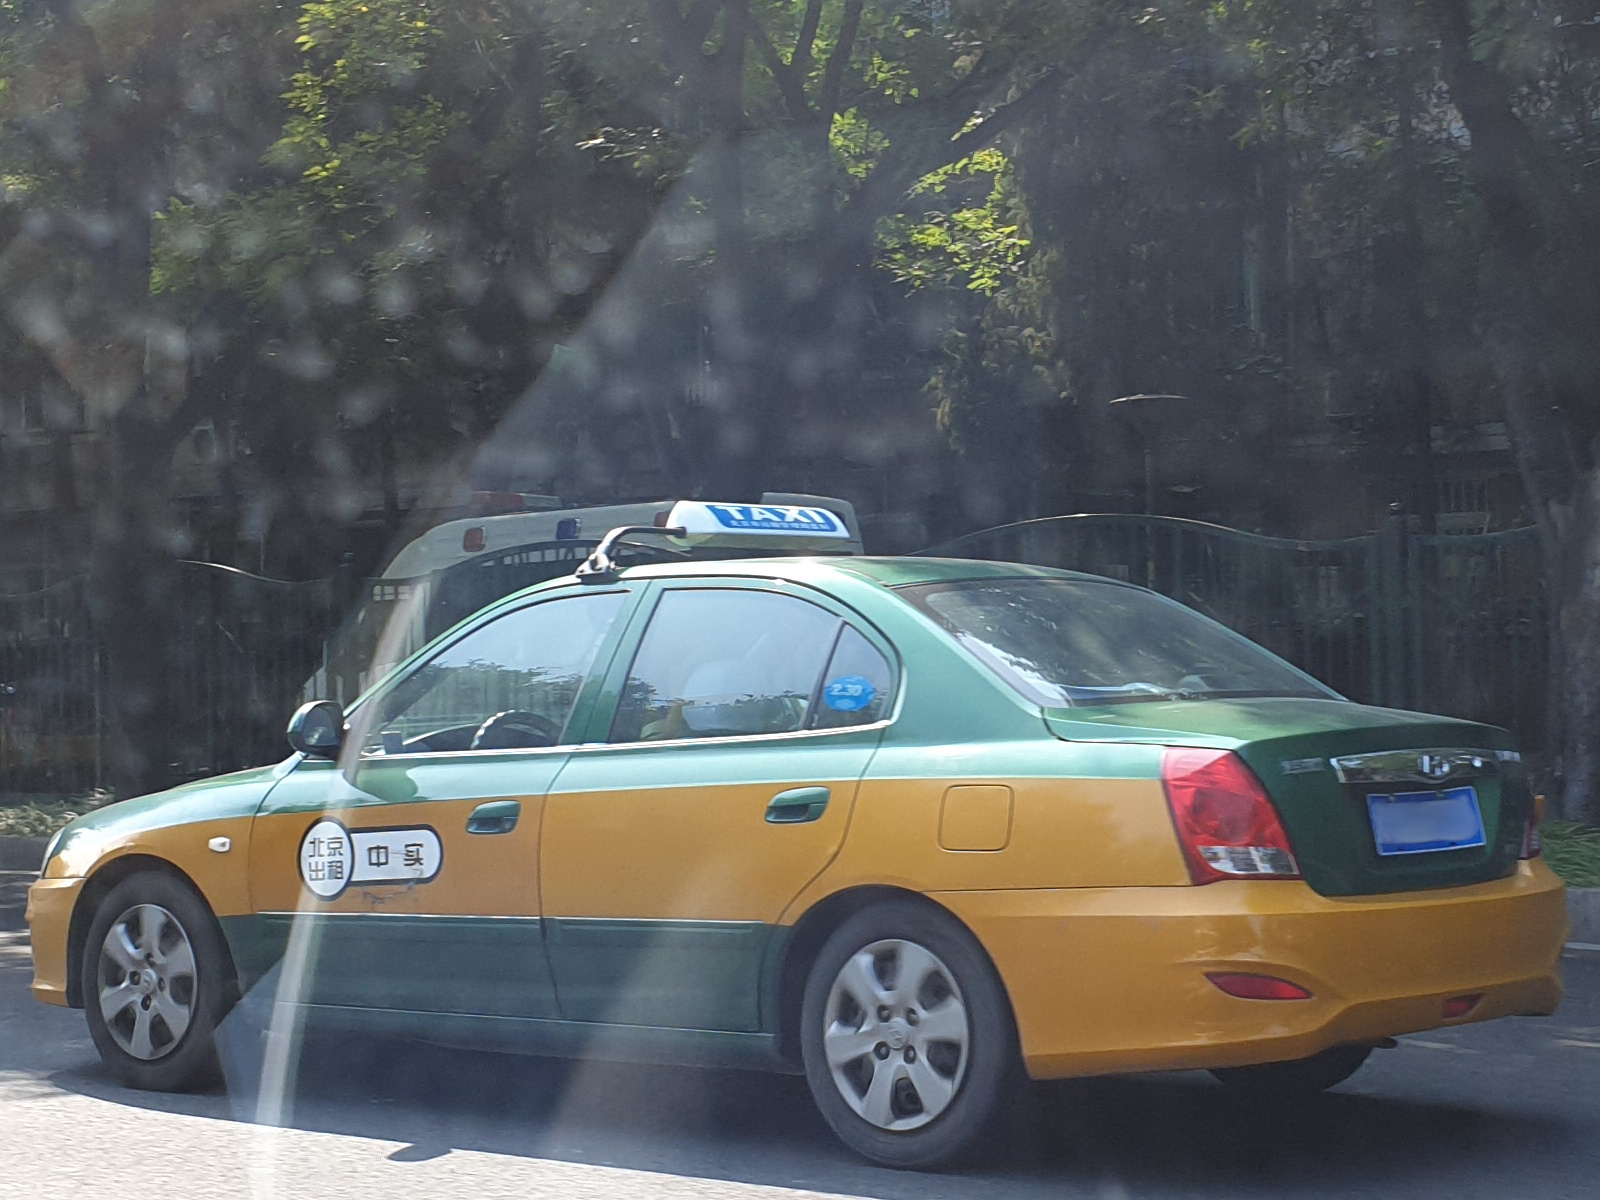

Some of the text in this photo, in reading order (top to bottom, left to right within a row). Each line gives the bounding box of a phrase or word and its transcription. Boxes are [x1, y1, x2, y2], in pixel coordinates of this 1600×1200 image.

[714, 505, 825, 523] TAXI
[308, 836, 344, 858] 北京
[308, 859, 344, 882] 出租
